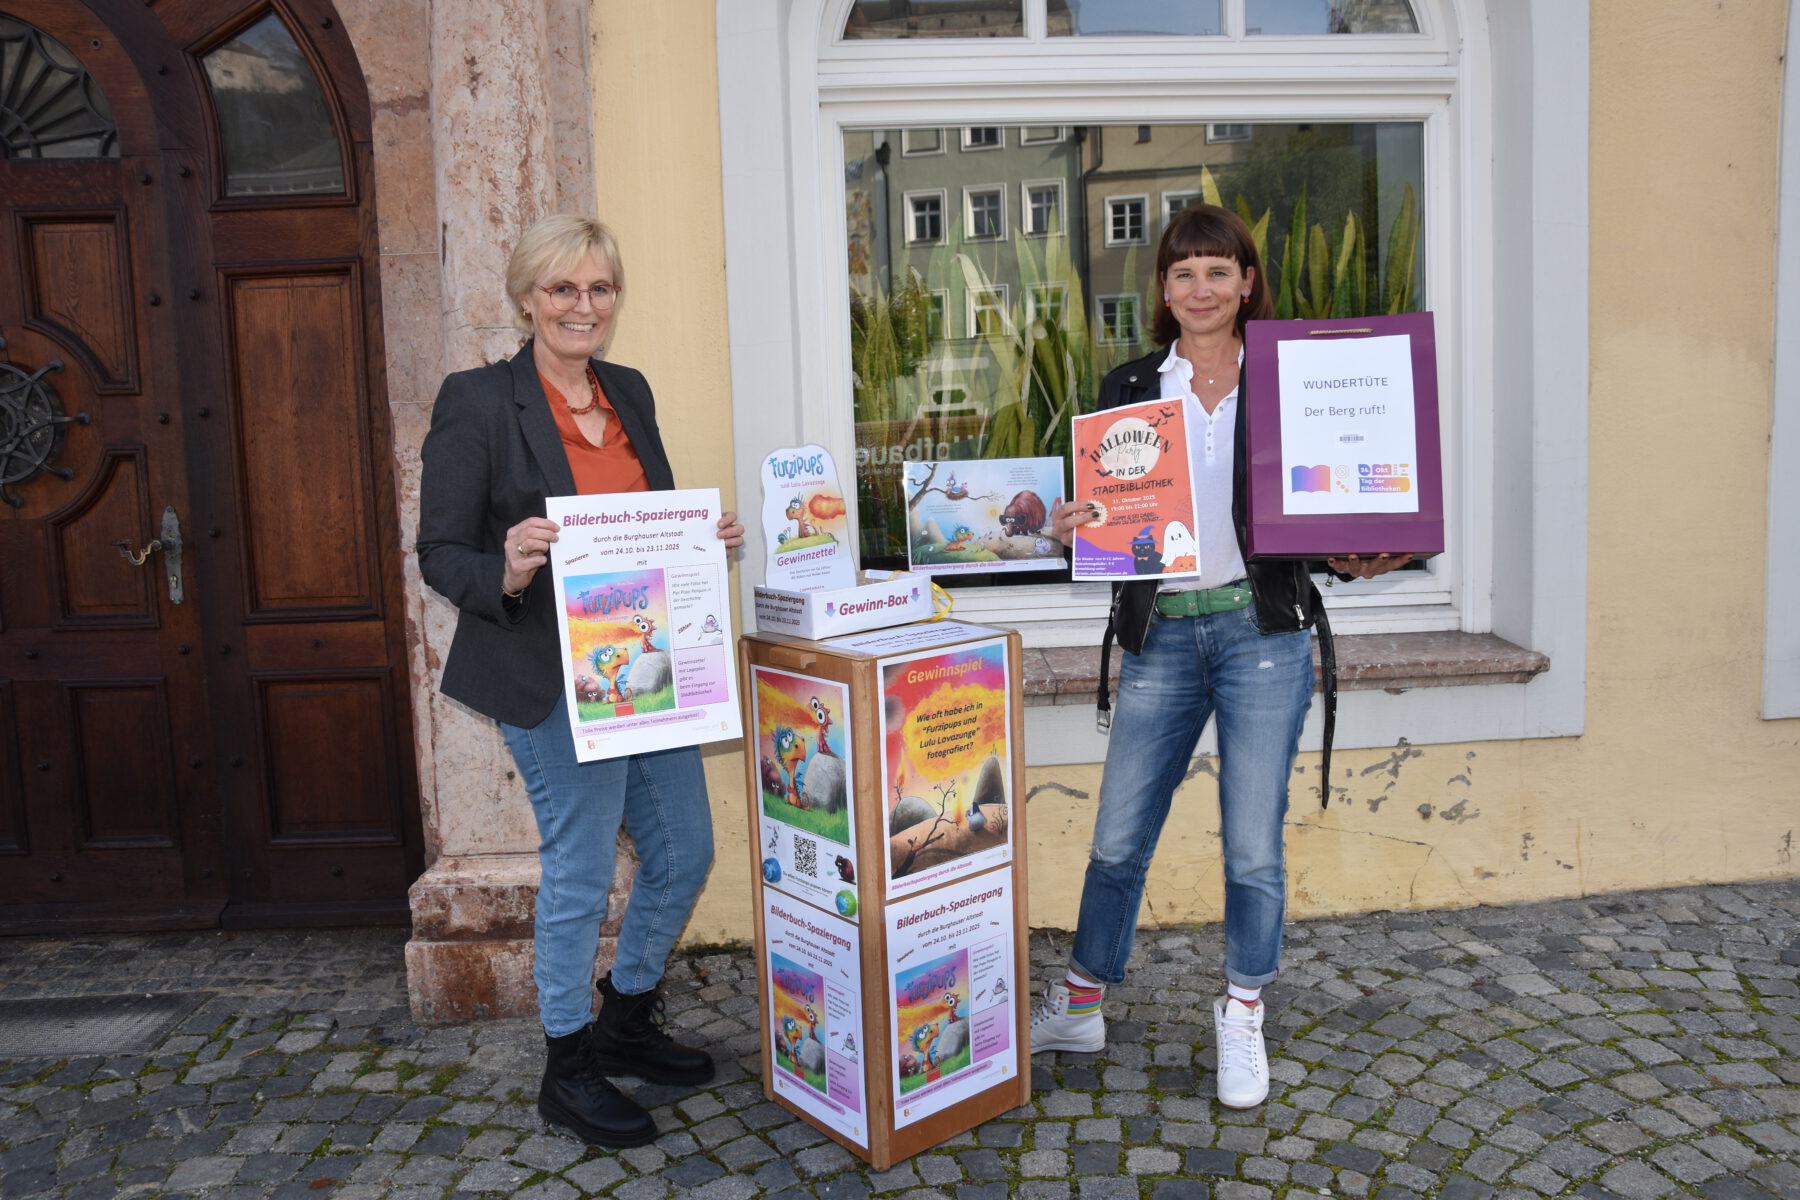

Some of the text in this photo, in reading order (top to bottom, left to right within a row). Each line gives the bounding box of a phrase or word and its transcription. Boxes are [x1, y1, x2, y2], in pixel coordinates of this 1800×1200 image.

[1303, 376, 1388, 390] WUNDERTÜTE
[1304, 404, 1386, 418] Der Berg ruft!
[1089, 430, 1173, 463] HALLOWEEN
[1115, 465, 1147, 477] IN DER
[1092, 478, 1174, 496] STADTBIBLIOTHEK
[563, 508, 709, 527] Bilderbuch-Spaziergang
[593, 536, 612, 544] durch
[624, 532, 659, 543] Burghauser
[660, 530, 684, 539] Altstadt
[615, 547, 635, 555] 24.10.
[636, 545, 645, 553] bis
[646, 543, 680, 553] 23.11.2025
[693, 544, 707, 552] Lesen
[777, 545, 836, 568] Gewinnzettel
[564, 552, 589, 566] Spazieren
[838, 594, 908, 617] Gewinn-Box
[907, 656, 983, 684] Gewinnspiel
[916, 701, 983, 723] Wie oft habe ich in
[963, 715, 977, 725] und
[919, 738, 936, 749] Lulu
[927, 741, 974, 760] fotografiert?
[896, 887, 1004, 930] Bilderbuch-Spaziergang
[771, 904, 852, 951] Bilderbuch-Spaziergang
[917, 911, 984, 939] durch die Burghauser Altstadt
[922, 940, 933, 949] vom
